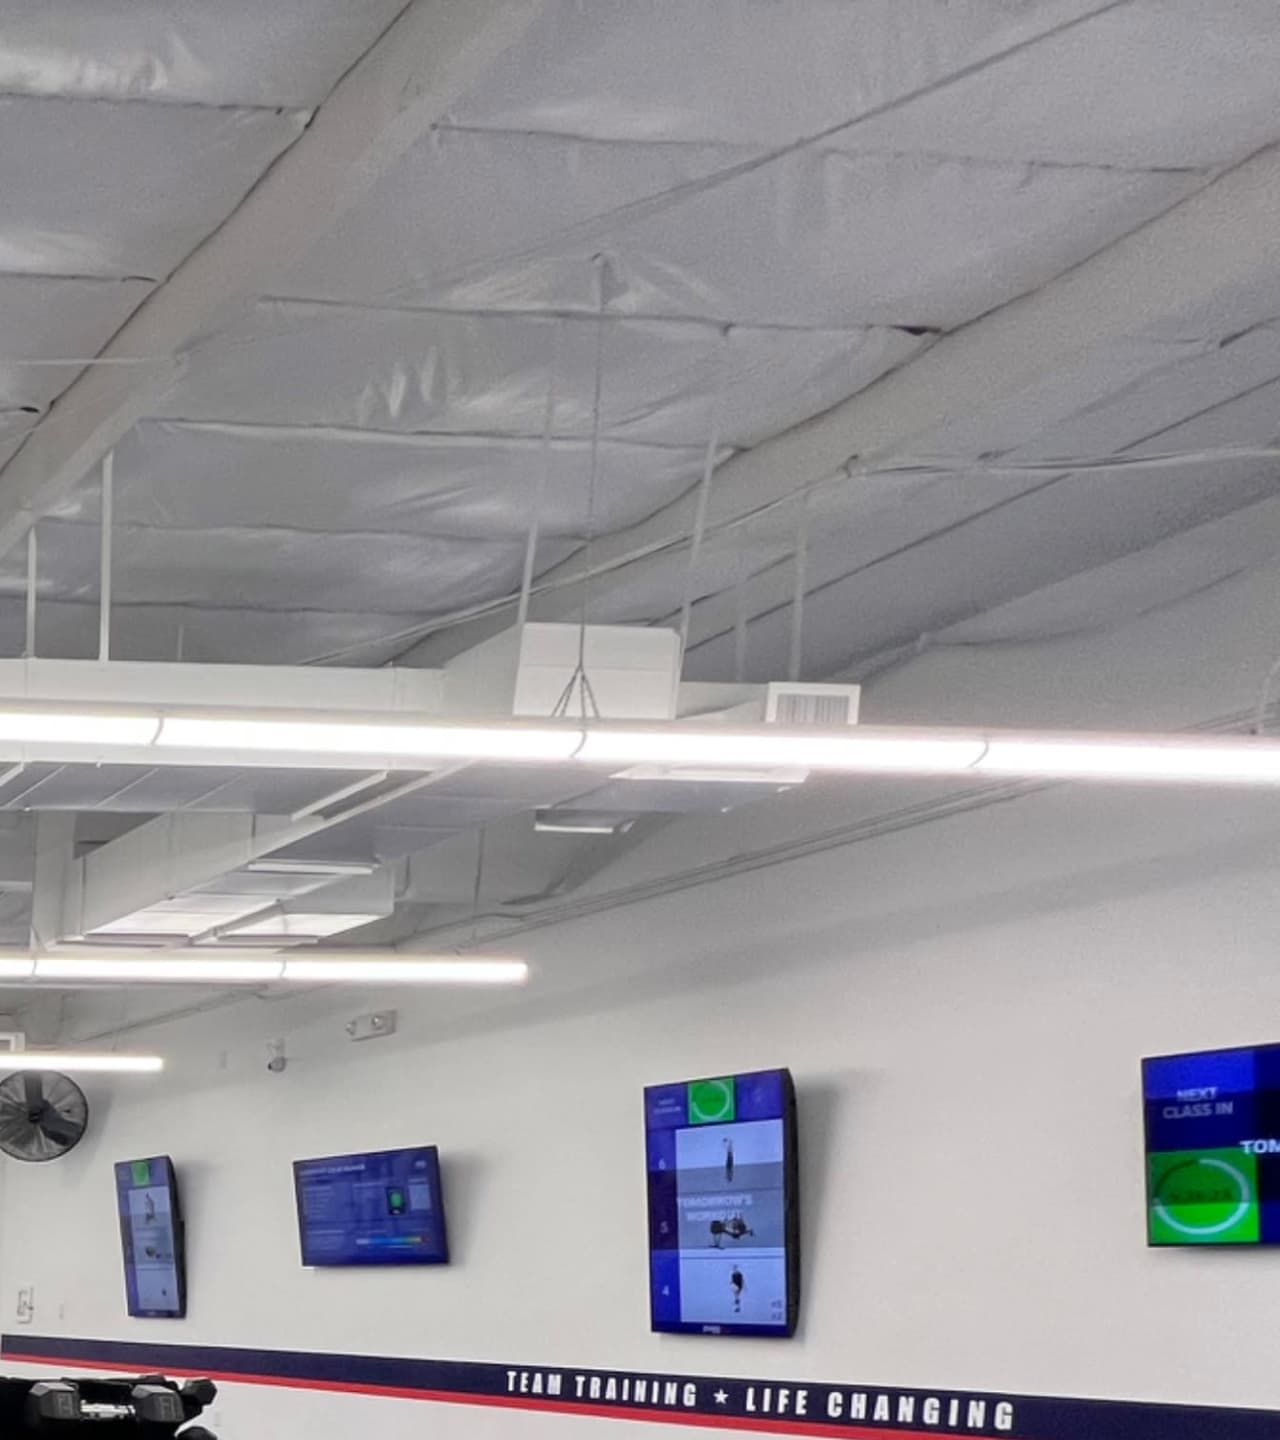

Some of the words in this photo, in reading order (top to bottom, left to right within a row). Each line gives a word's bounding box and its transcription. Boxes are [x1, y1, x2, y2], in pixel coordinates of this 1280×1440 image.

[1163, 1104, 1212, 1119] CLASS
[1216, 1102, 1233, 1115] IN
[506, 1371, 562, 1395] TEAM
[575, 1375, 697, 1407] TRAINING
[745, 1387, 808, 1415] LIFE
[827, 1391, 1014, 1431] CHANGING
